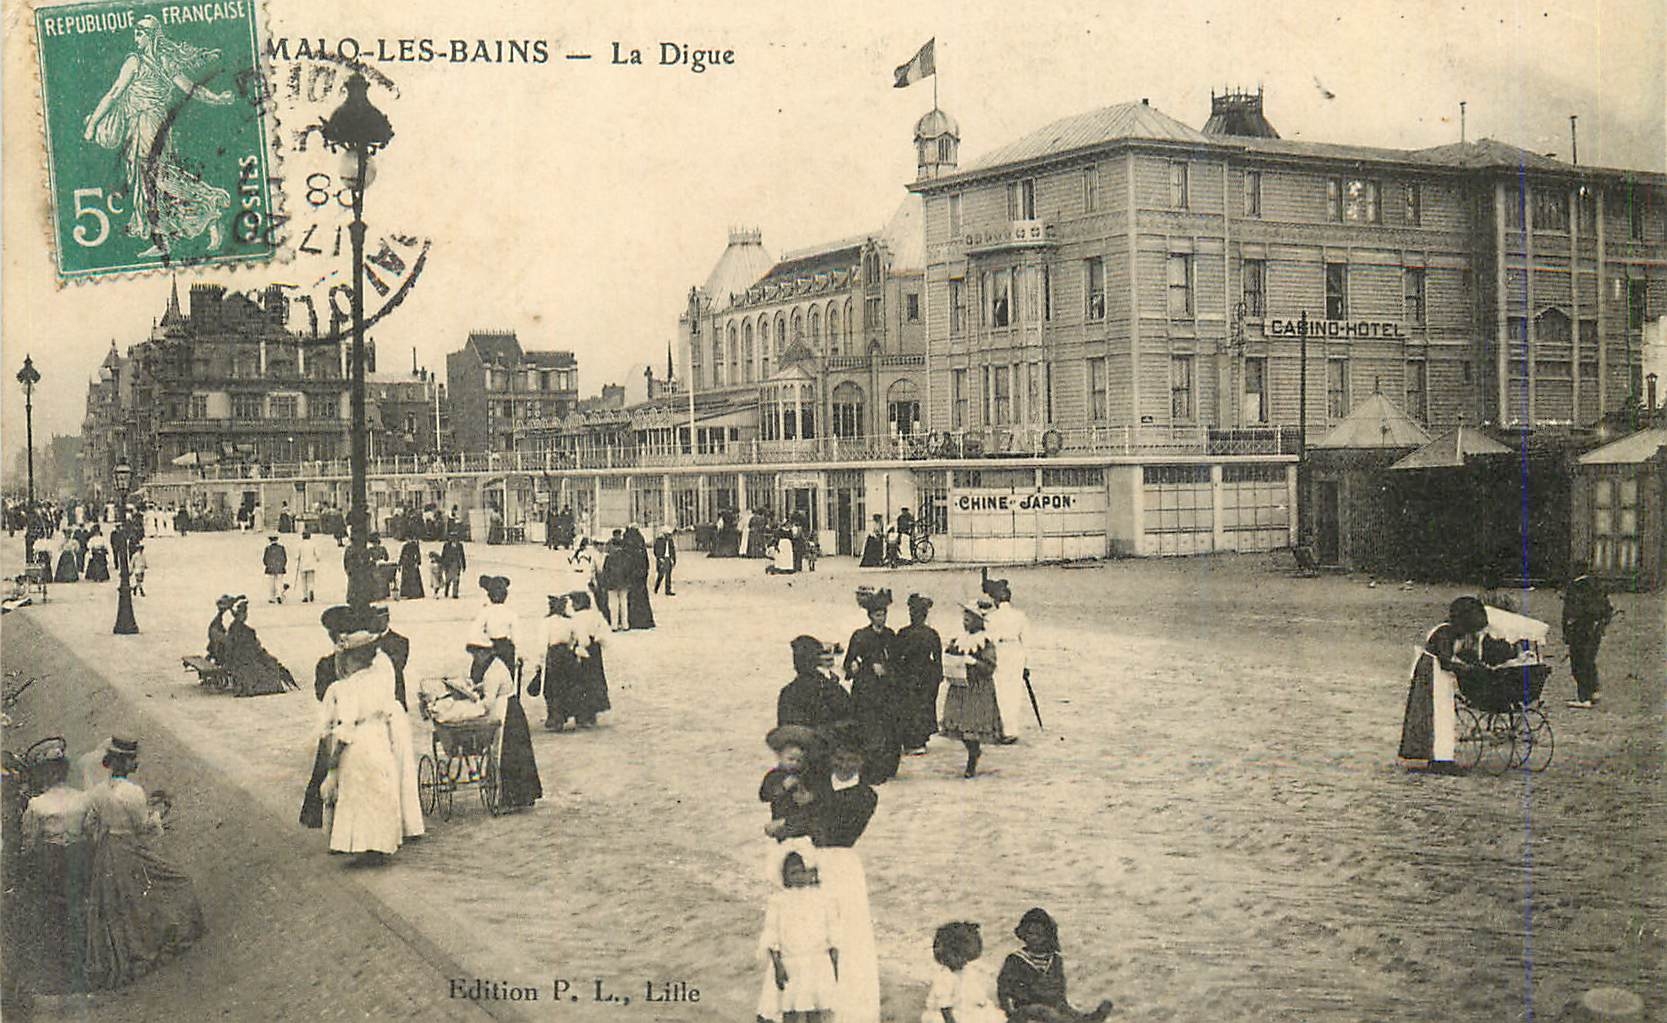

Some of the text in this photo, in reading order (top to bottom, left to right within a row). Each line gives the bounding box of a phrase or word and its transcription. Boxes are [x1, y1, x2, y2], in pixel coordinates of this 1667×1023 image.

[161, 1, 246, 25] FRANÇAISE
[959, 495, 1008, 510] CHINE
[1020, 494, 1071, 510] JAPON
